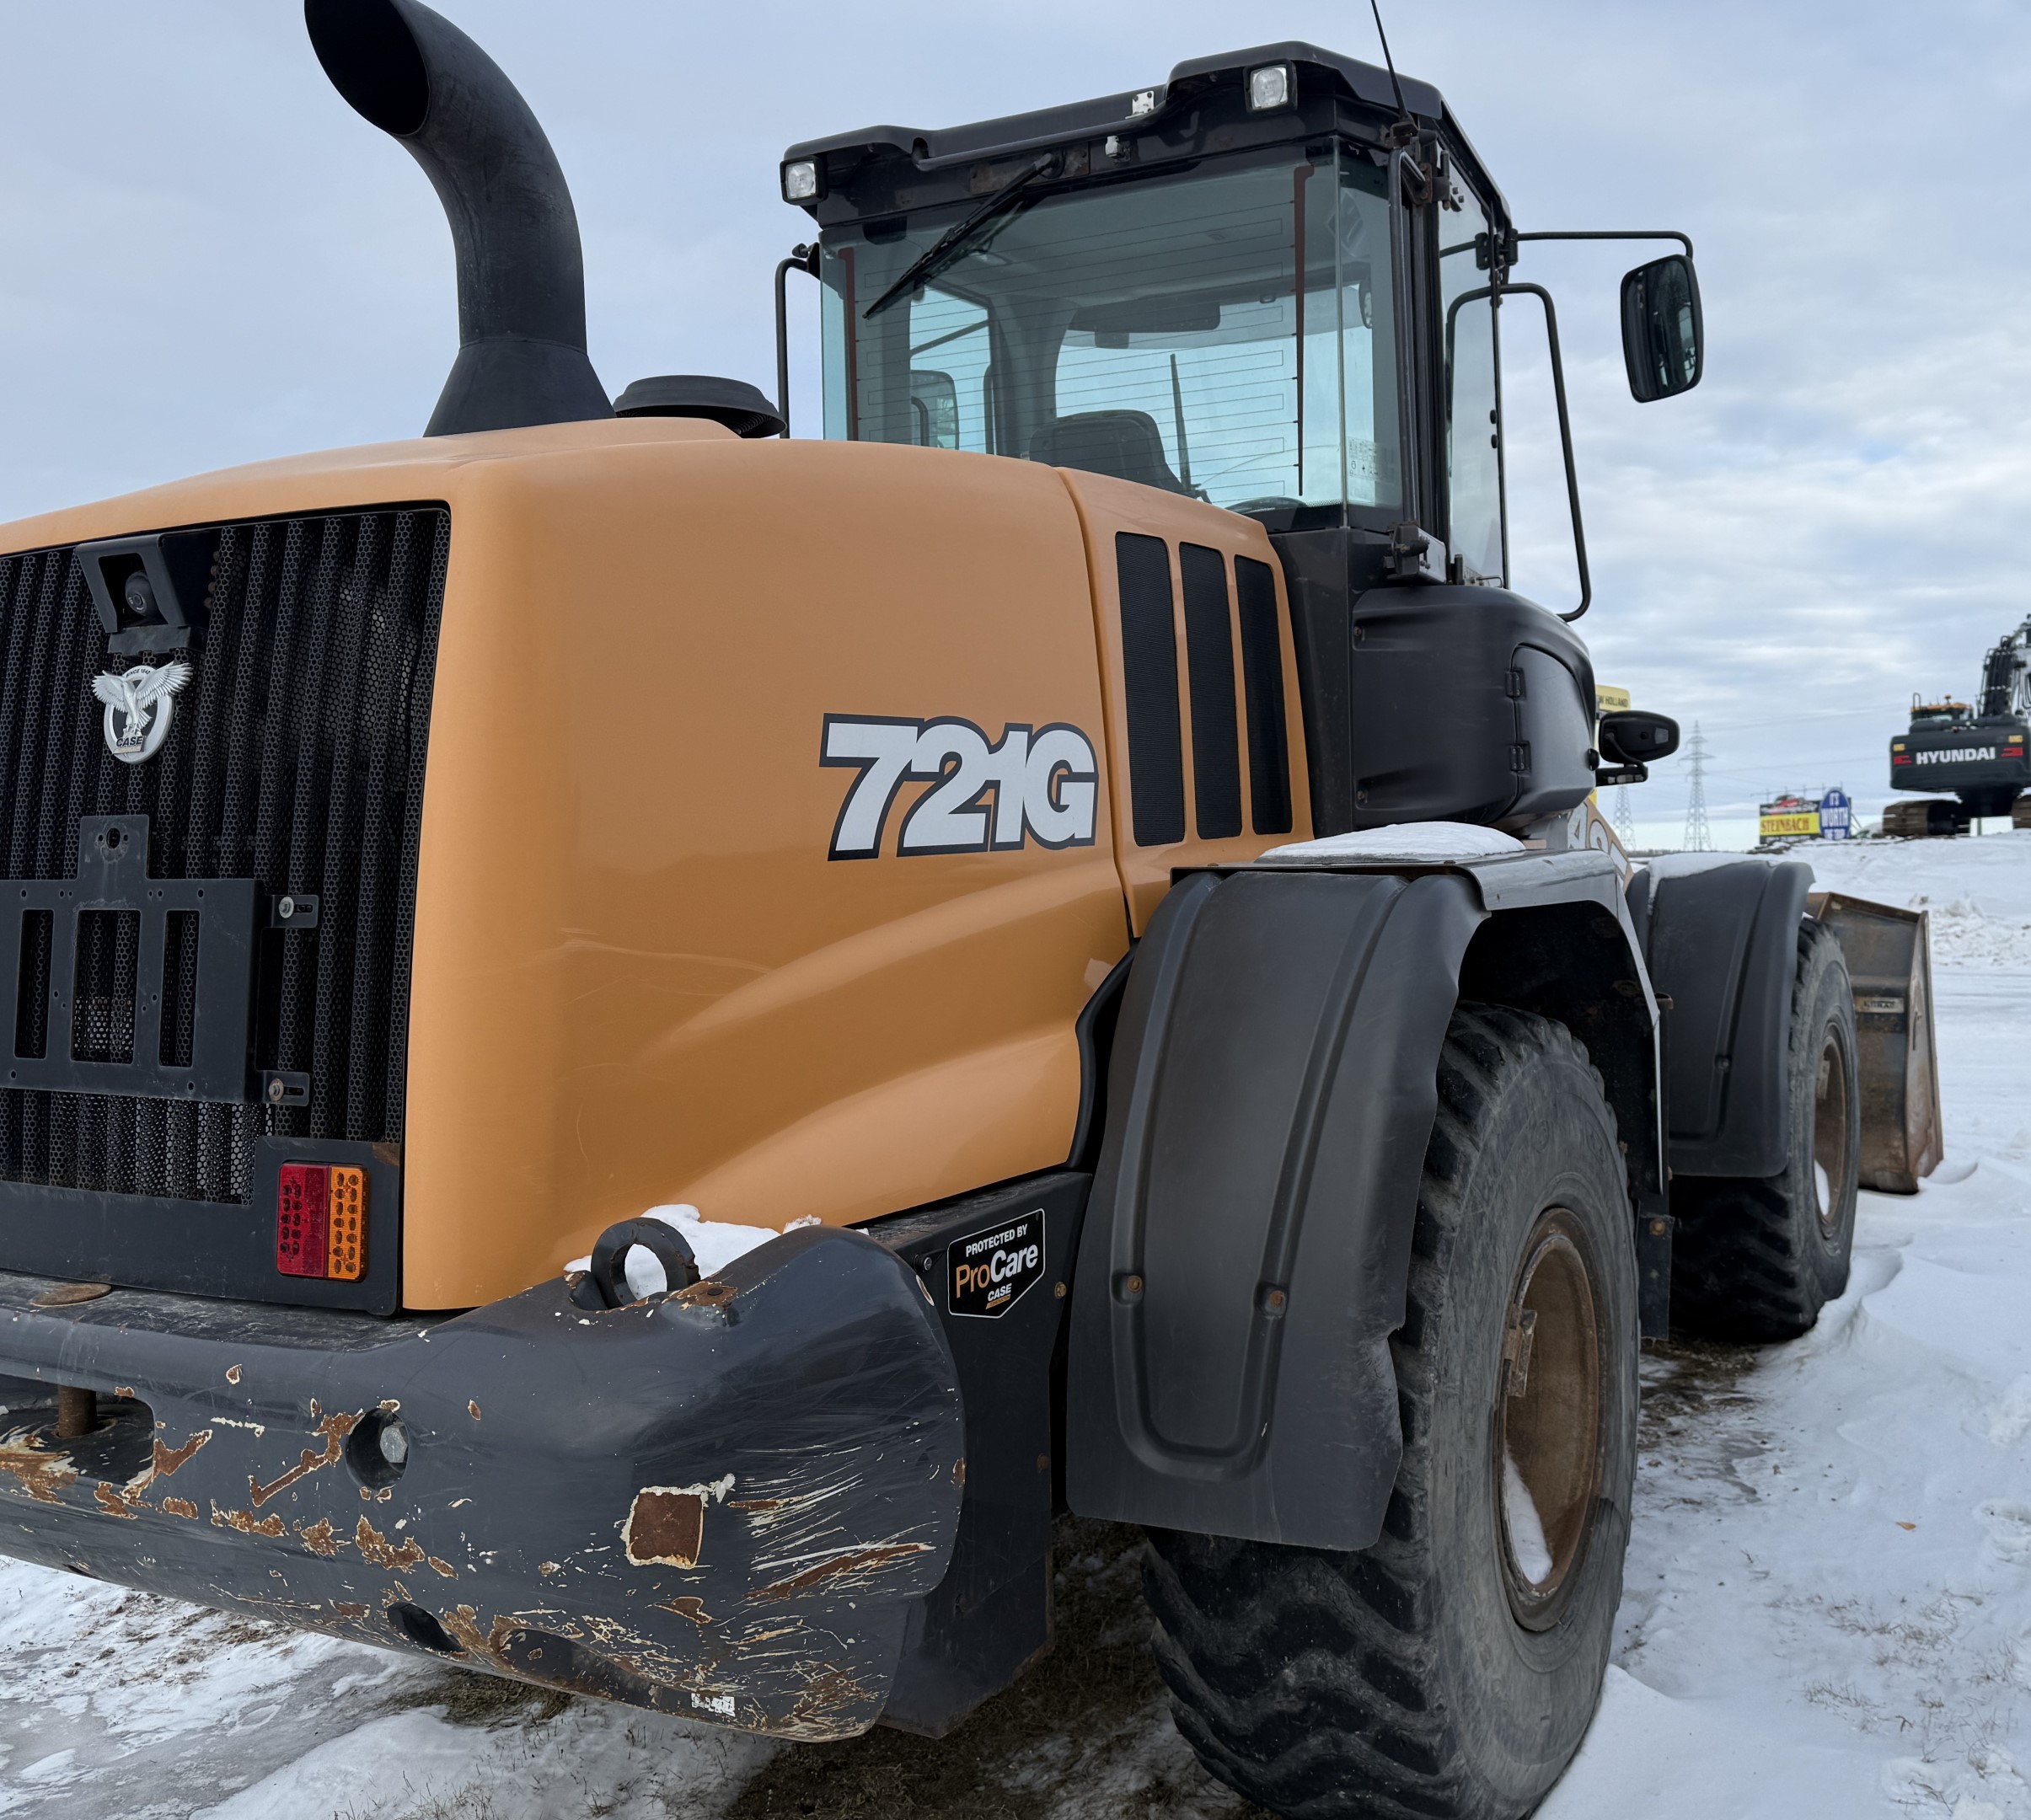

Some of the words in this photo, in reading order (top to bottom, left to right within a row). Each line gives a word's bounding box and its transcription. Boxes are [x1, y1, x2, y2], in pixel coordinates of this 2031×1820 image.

[116, 736, 143, 747] CASE
[1916, 747, 1996, 765] HYUNDAI
[819, 713, 1099, 861] 721G
[1760, 817, 1809, 832] STEINBACH
[1821, 807, 1848, 827] WORTH
[966, 1228, 1016, 1257] PROTECTED
[1016, 1223, 1028, 1238] BY
[956, 1244, 1038, 1298] ProCare
[988, 1282, 1012, 1302] CASE
